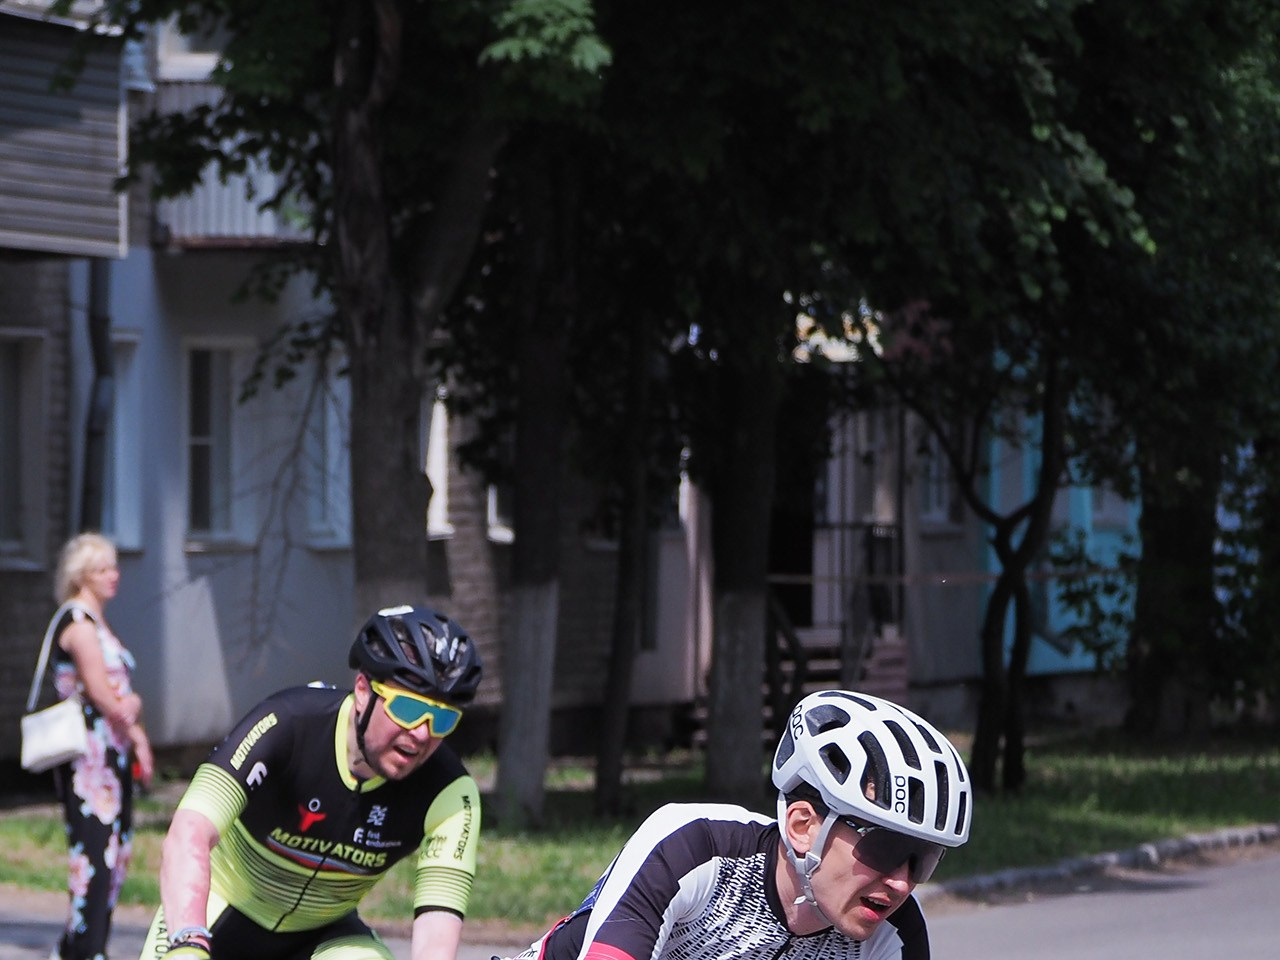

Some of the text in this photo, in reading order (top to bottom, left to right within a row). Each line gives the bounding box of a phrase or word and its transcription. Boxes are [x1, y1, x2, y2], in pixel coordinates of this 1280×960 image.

[230, 712, 278, 771] MOTIVATORS
[271, 827, 388, 867] MOTIVATORS
[454, 795, 472, 860] MOTIVATORS
